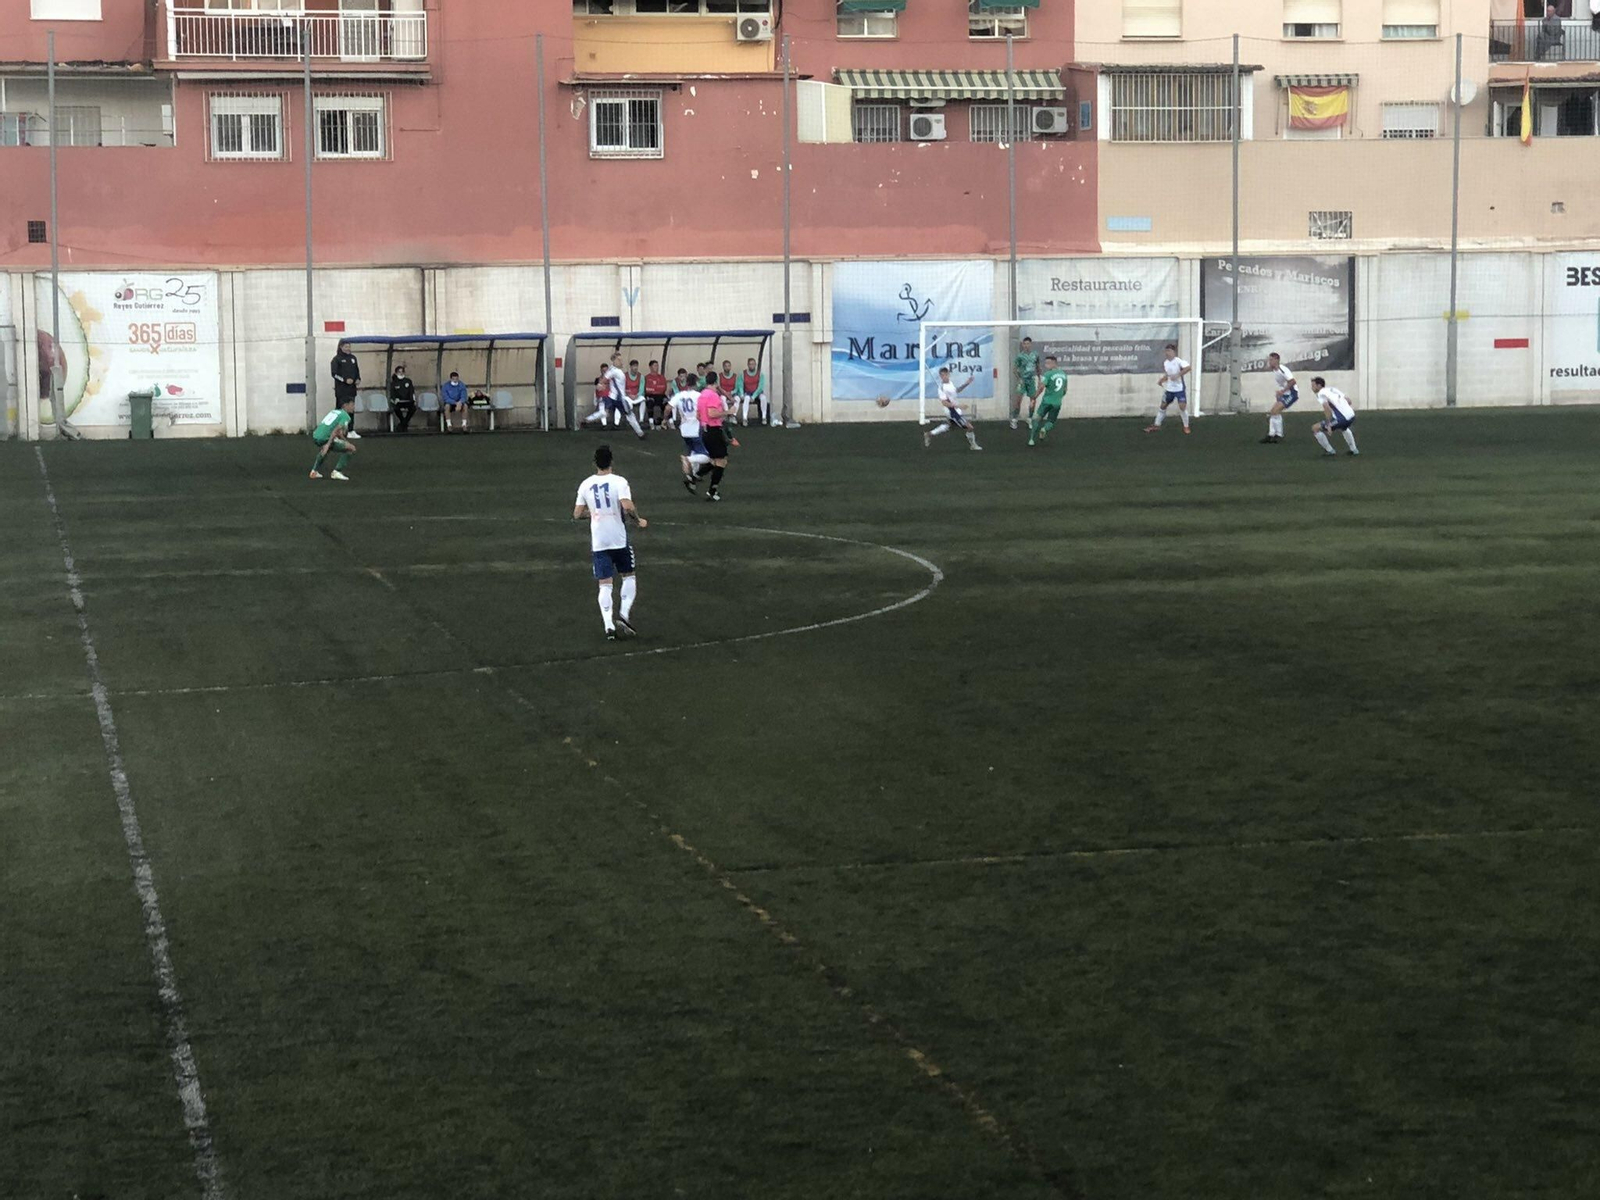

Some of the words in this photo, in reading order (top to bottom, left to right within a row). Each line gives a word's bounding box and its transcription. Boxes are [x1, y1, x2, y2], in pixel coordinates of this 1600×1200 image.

[1218, 260, 1273, 278] Pecados
[1285, 269, 1340, 287] Mariscos
[165, 278, 205, 305] 25
[1050, 277, 1143, 292] Restaurante
[113, 302, 133, 311] Reyes
[128, 323, 161, 344] 365
[167, 326, 194, 341] días
[847, 334, 981, 361] Marina
[1043, 345, 1091, 355] Especialidad
[1063, 354, 1071, 362] la
[1072, 354, 1093, 362] brasa
[949, 361, 983, 375] Playa
[1054, 378, 1063, 392] 9
[681, 397, 694, 413] 10
[590, 482, 611, 509] 11
